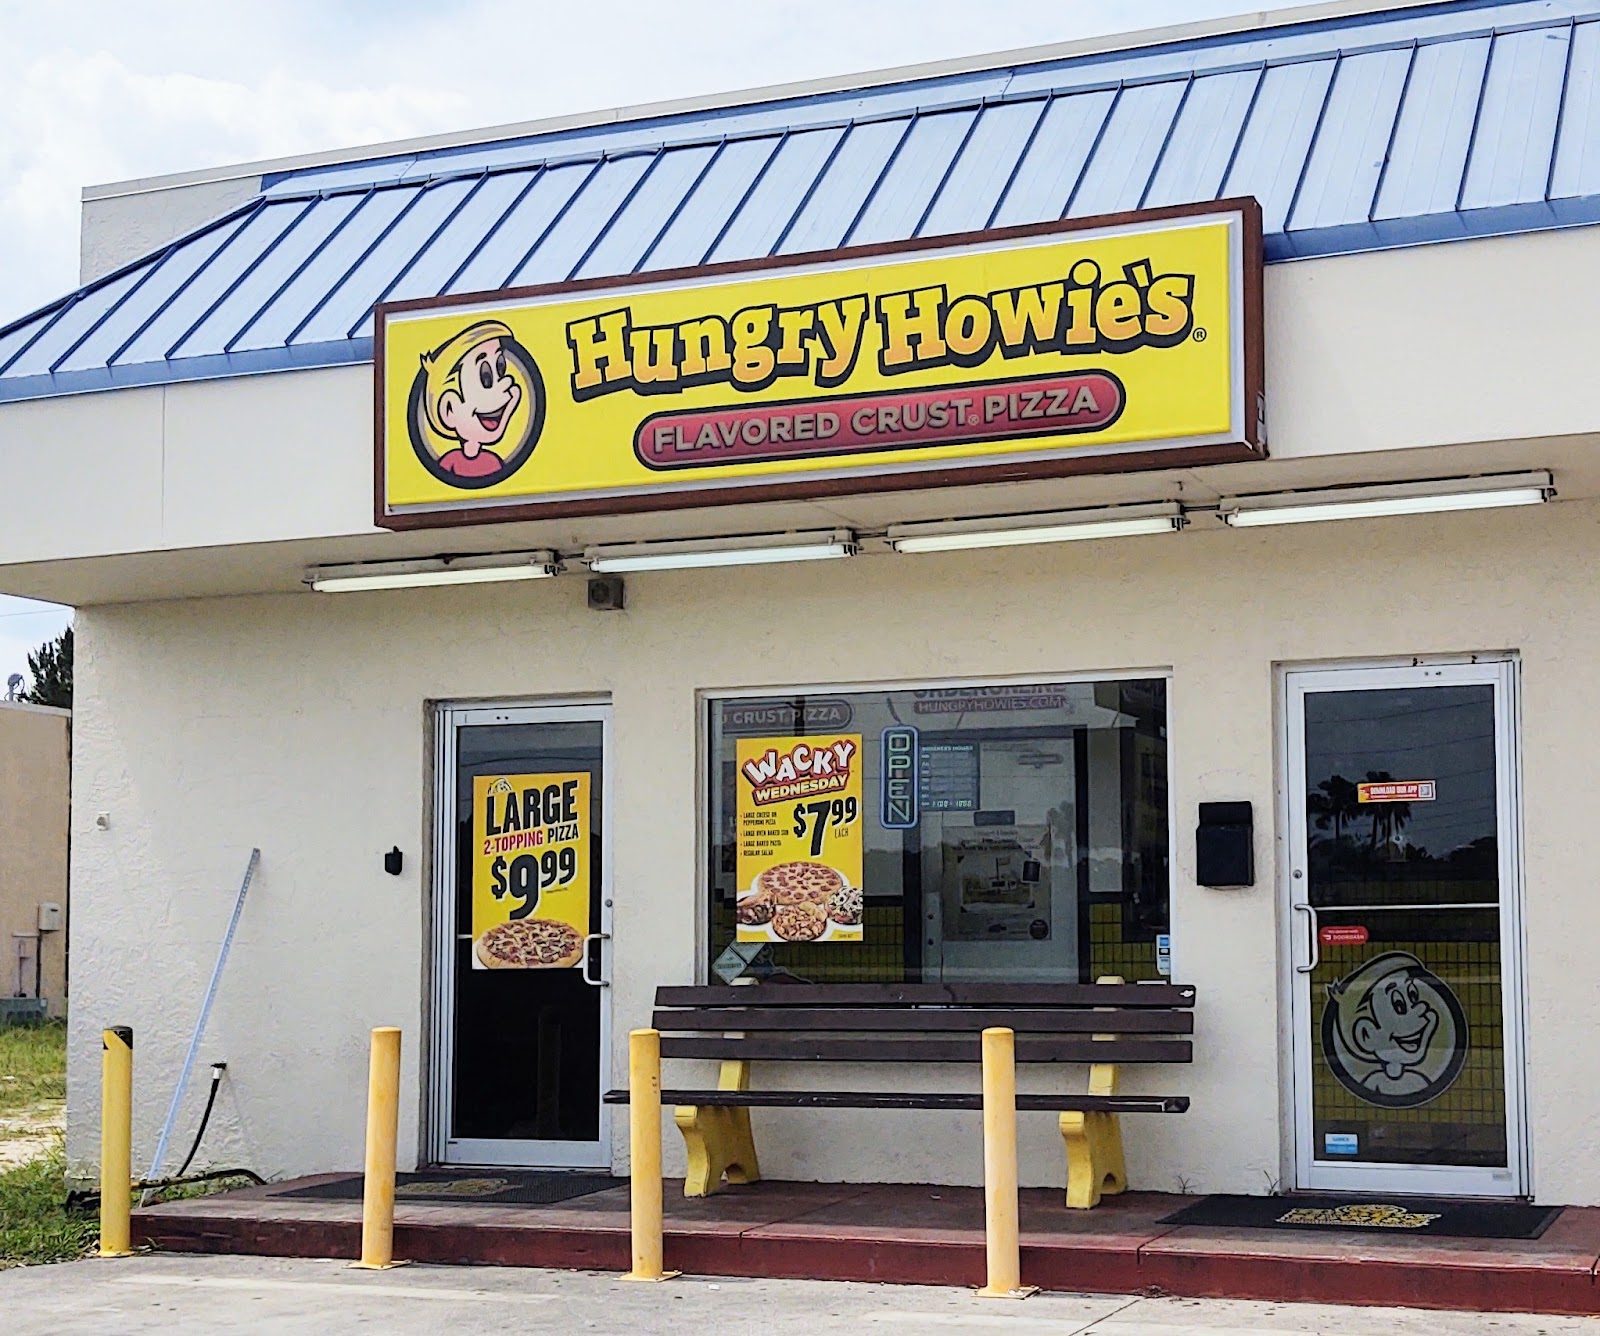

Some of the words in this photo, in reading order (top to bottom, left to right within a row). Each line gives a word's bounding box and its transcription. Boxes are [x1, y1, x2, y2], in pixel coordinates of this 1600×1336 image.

[567, 293, 869, 403] Hungry
[877, 259, 1194, 376] Howie's
[654, 412, 841, 454] FLAVORED
[851, 399, 972, 436] CRUST
[985, 385, 1099, 423] PIZZA
[732, 709, 786, 725] CRUST
[792, 707, 842, 722] PIZZA
[744, 740, 856, 784] WACKY
[888, 733, 911, 823] OPEN
[486, 780, 578, 837] LARGE
[755, 774, 848, 802] WEDNESDAY
[484, 830, 544, 855] 2-TOPPING
[547, 823, 579, 844] PIZZA
[834, 828, 849, 839] EACH
